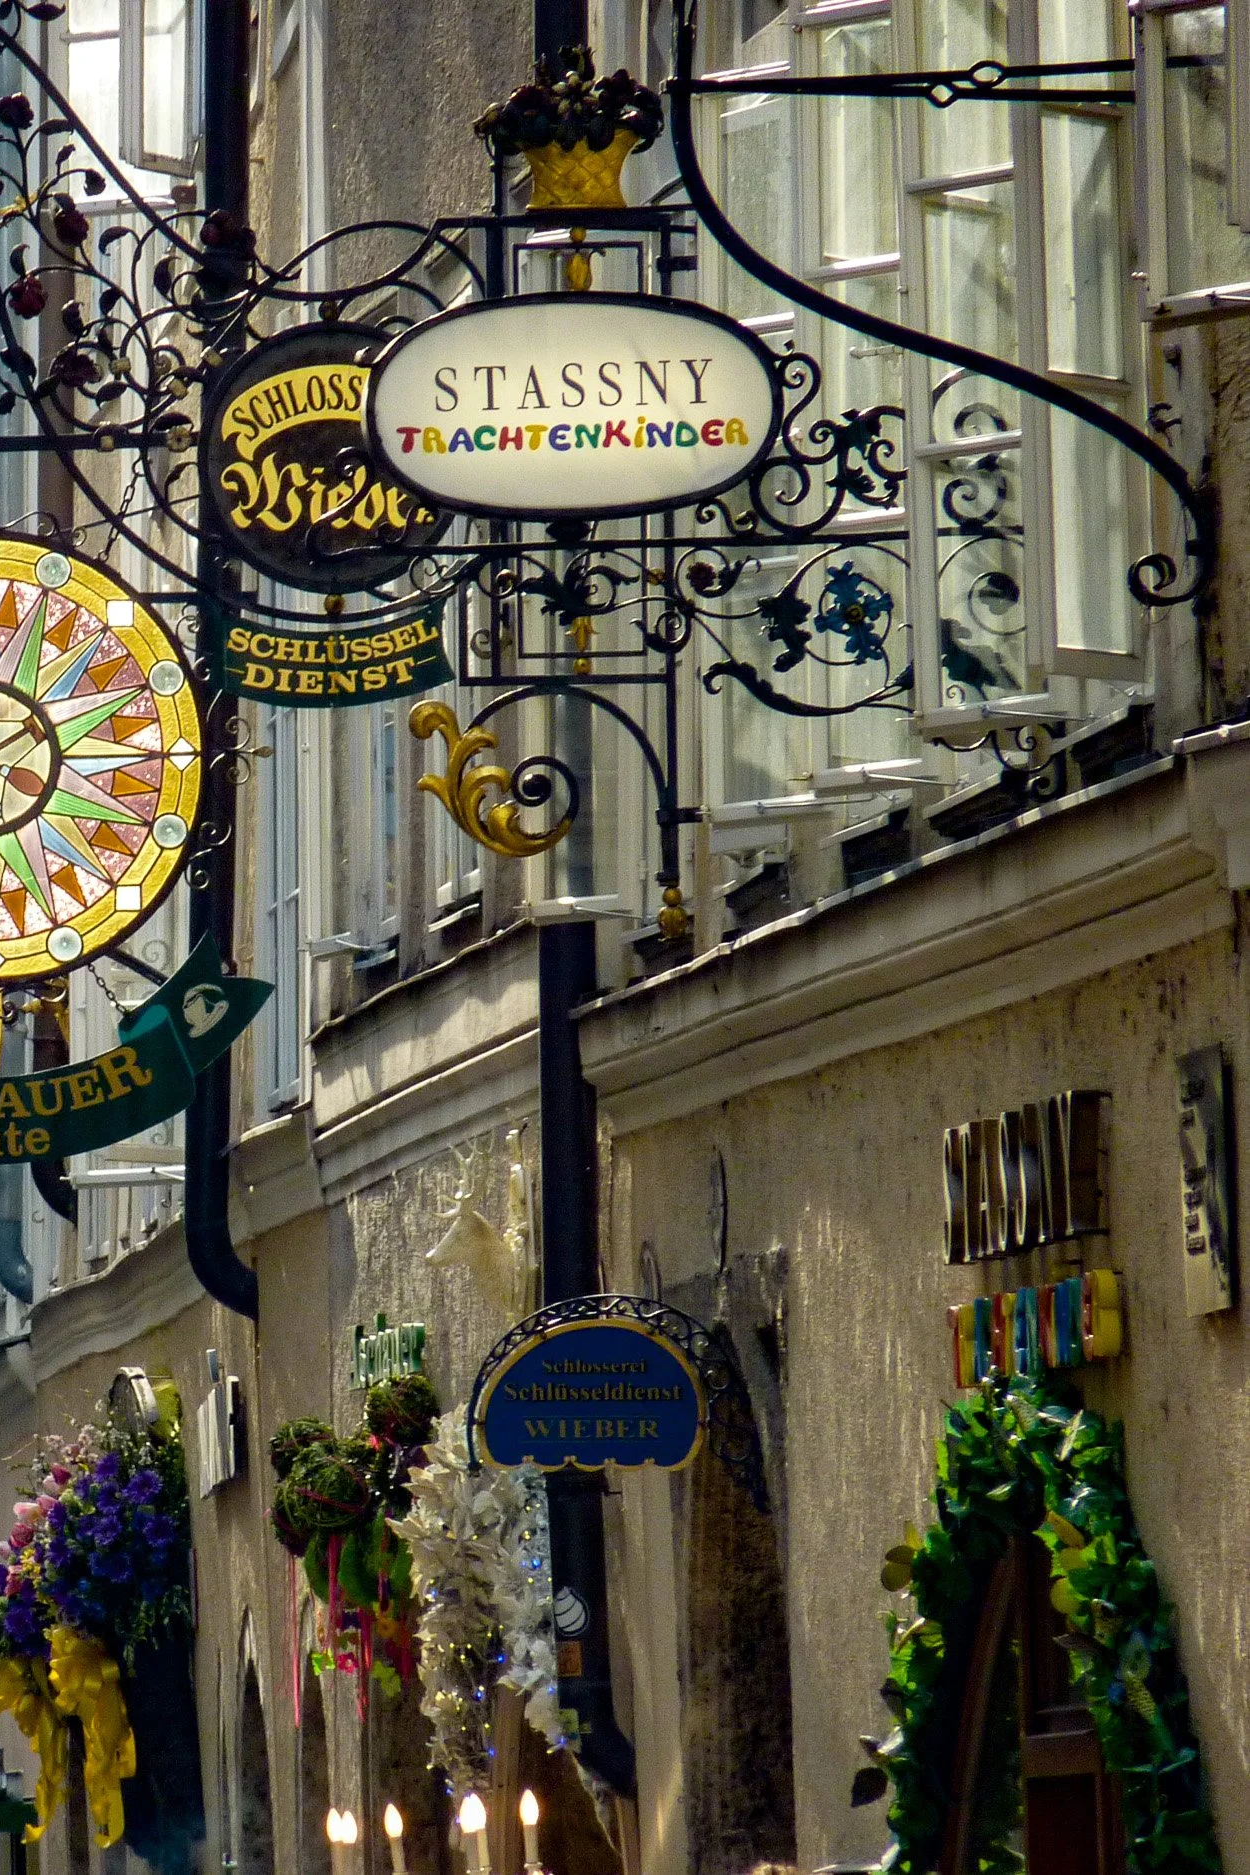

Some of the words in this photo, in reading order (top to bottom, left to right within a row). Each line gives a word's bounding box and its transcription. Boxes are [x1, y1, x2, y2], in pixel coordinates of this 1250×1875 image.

[433, 358, 713, 413] STASSNY
[231, 373, 364, 442] SCHLOSS
[227, 617, 439, 665] SCHLÜSSEL
[240, 657, 416, 695] DIENST
[542, 1359, 648, 1375] Schlosserei
[503, 1382, 682, 1402] Schlüsseldienst
[523, 1418, 659, 1440] WIEBER
